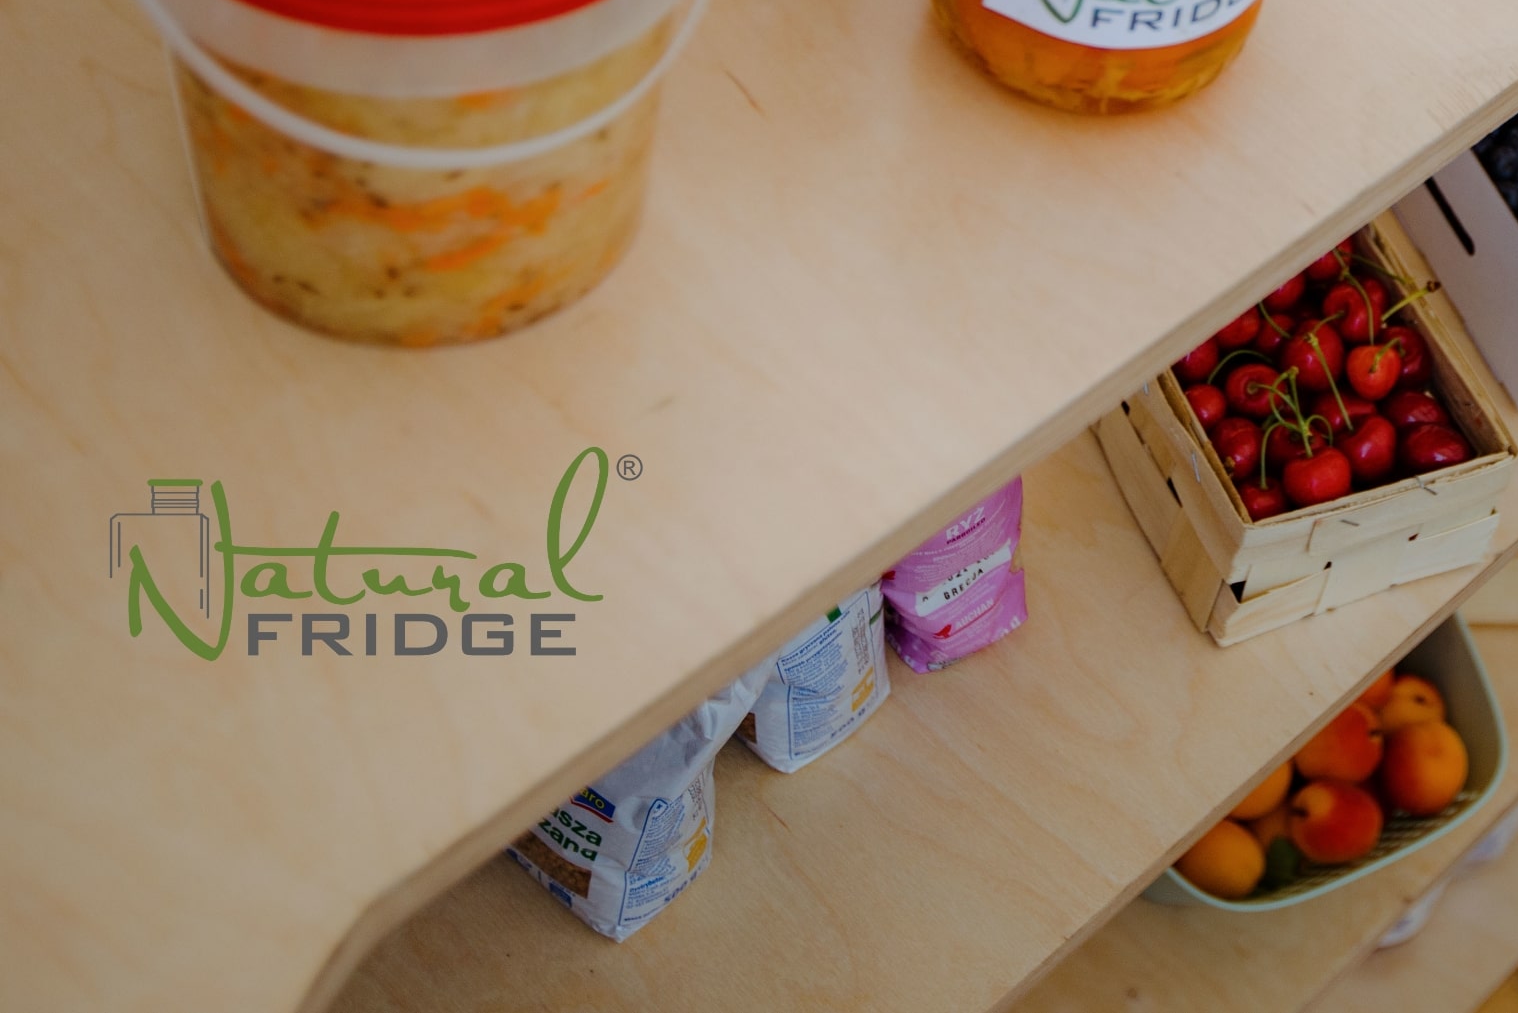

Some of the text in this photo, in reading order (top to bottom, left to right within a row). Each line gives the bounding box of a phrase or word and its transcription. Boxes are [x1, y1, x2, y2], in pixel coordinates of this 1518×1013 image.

[943, 568, 985, 601] GRECJA
[955, 598, 995, 630] AUCHAN
[580, 787, 606, 810] aro
